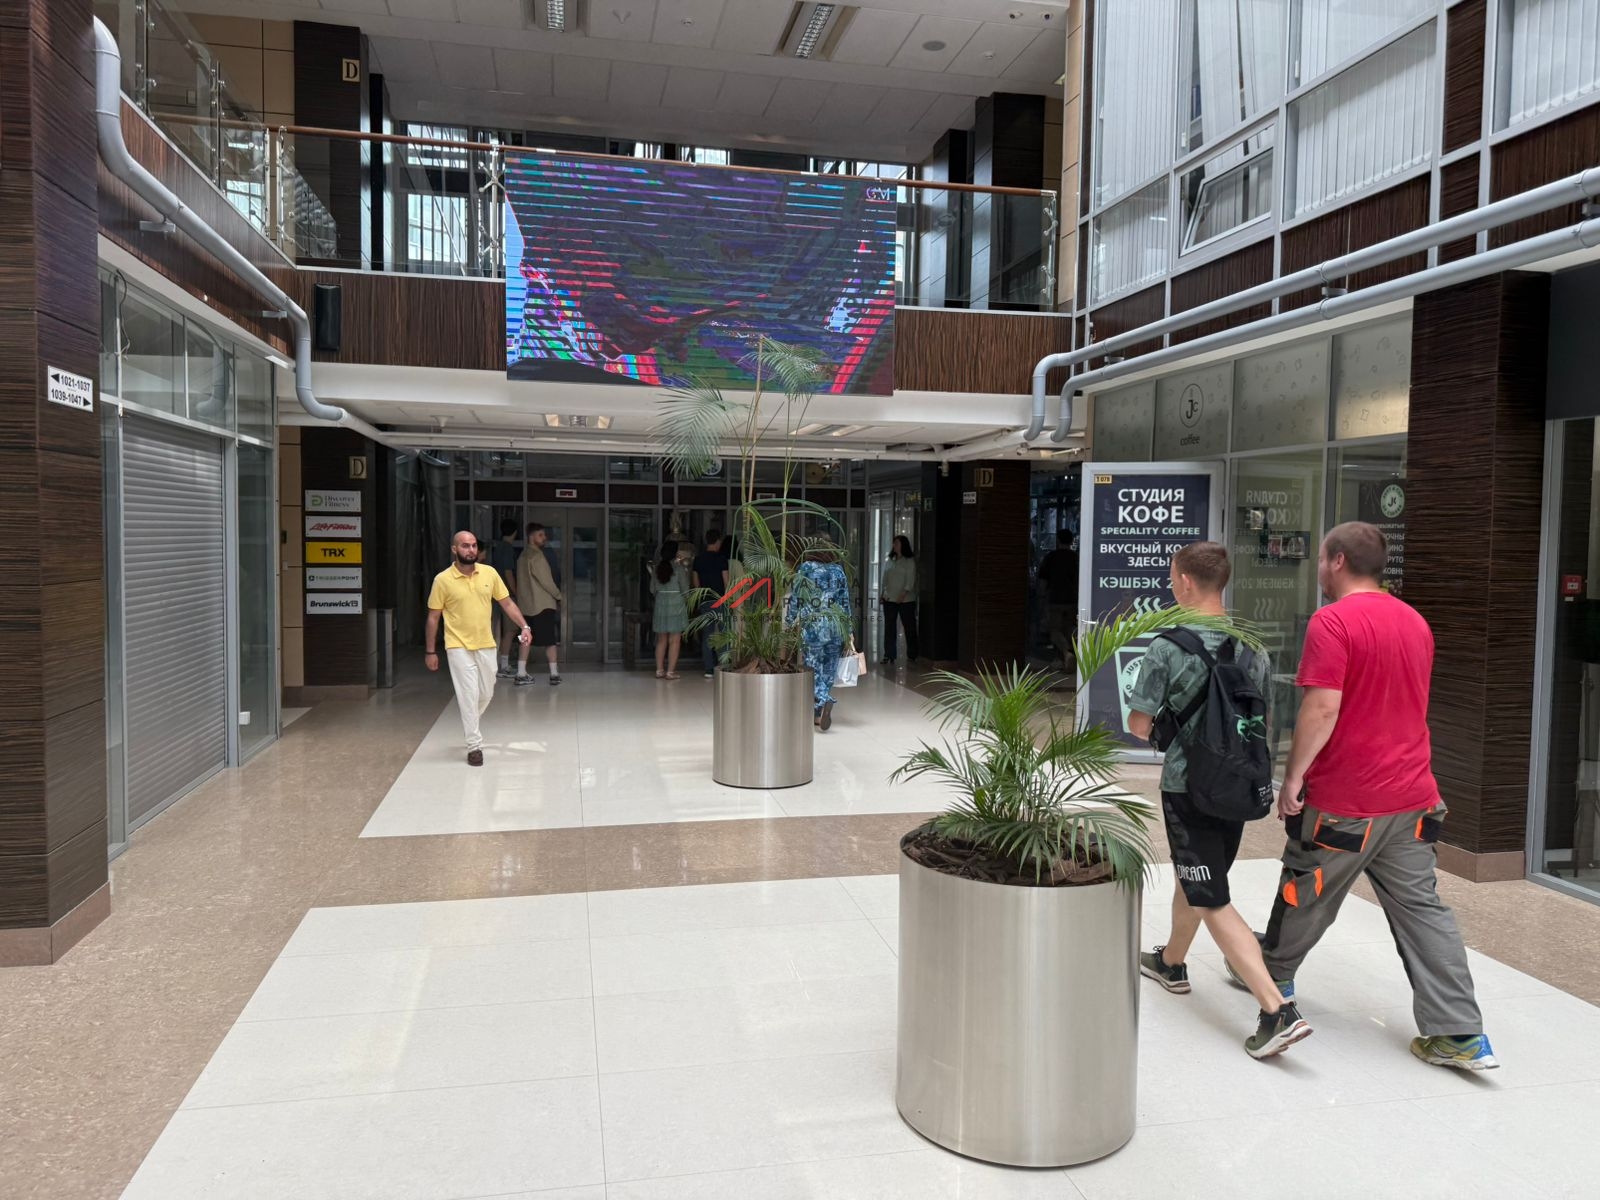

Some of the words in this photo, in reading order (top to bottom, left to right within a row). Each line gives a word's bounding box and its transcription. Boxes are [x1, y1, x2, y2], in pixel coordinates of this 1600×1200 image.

[344, 61, 358, 79] D
[352, 458, 364, 476] D
[982, 470, 993, 485] D
[1117, 488, 1185, 503] СТУДИЯ
[1117, 505, 1184, 523] КОФЕ
[1100, 527, 1159, 535] SPECIALITY
[1161, 527, 1200, 535] COFFEE
[320, 548, 346, 558] TRX
[1100, 541, 1161, 554] ВКУСНЫЙ
[1165, 544, 1189, 554] КО
[1128, 556, 1171, 568] ЗДЕСЬ!
[1099, 577, 1161, 589] КЭШБЭК
[1166, 577, 1174, 589] 2
[310, 600, 350, 608] Brunswick
[1177, 864, 1212, 881] DREAM
